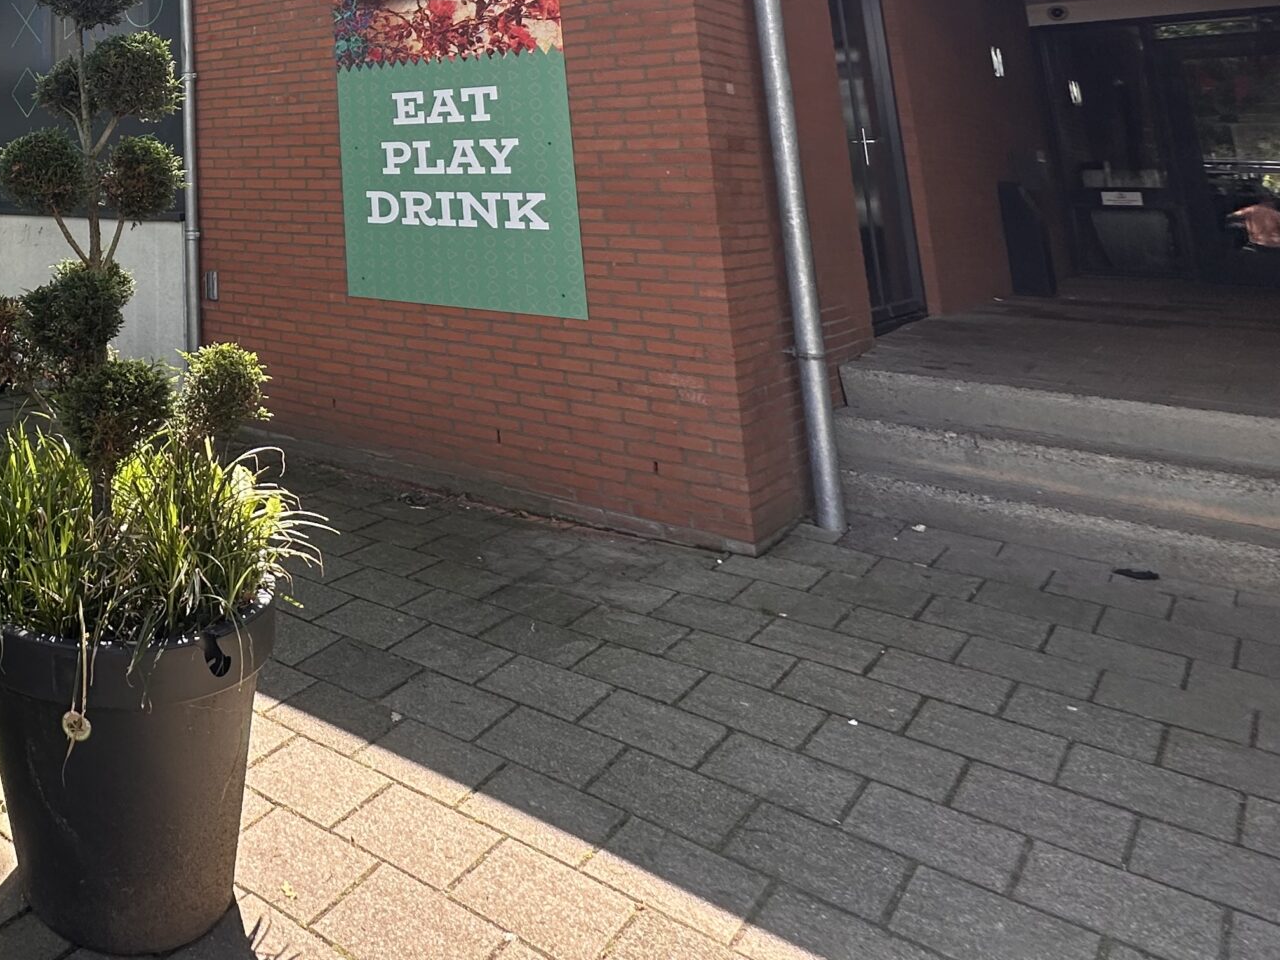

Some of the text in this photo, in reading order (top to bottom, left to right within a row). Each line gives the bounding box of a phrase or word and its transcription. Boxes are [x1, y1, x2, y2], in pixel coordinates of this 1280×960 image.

[391, 85, 498, 125] EAT
[381, 137, 519, 175] PLAY
[365, 190, 550, 230] DRINK
